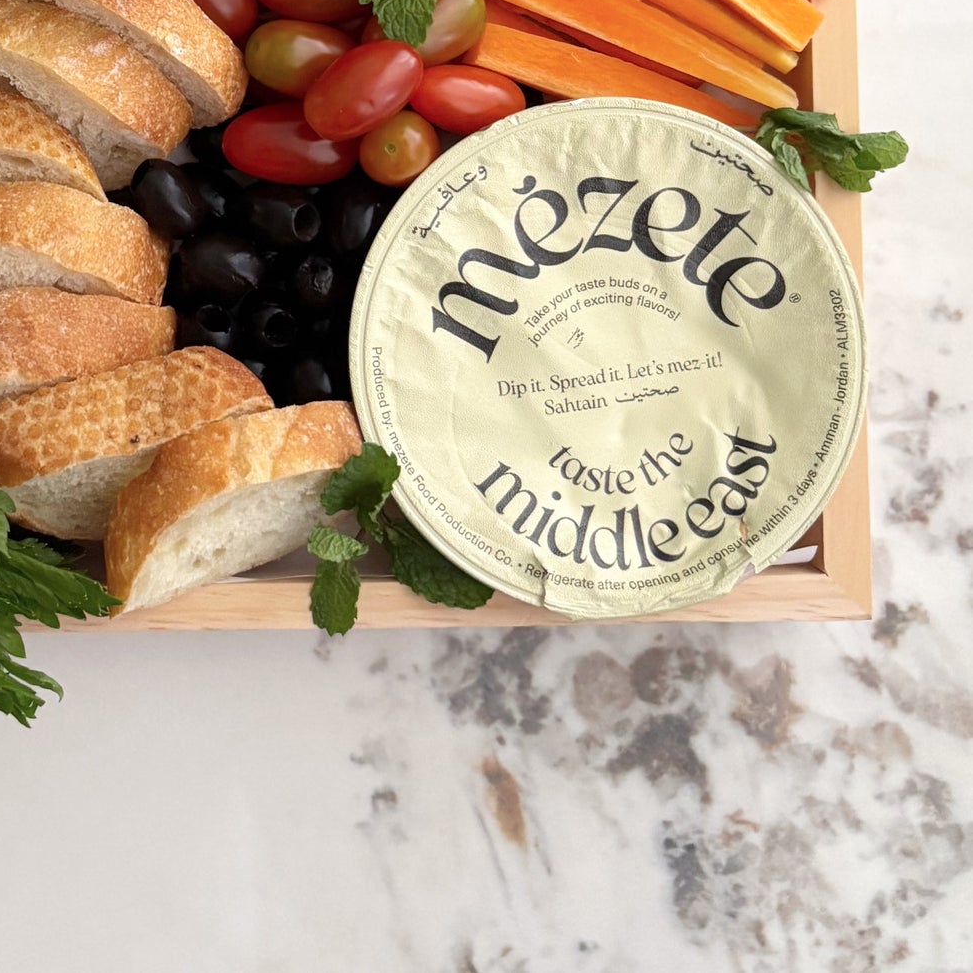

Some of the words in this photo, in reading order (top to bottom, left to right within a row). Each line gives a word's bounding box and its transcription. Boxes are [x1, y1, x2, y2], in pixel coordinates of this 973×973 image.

[690, 139, 773, 196] صحتين
[524, 304, 550, 328] Take
[549, 287, 573, 310] your
[575, 278, 605, 293] taste
[609, 276, 640, 290] buds
[642, 283, 658, 295] on
[659, 291, 668, 300] a
[528, 309, 568, 347] journey
[570, 300, 581, 314] of
[584, 293, 633, 307] exciting
[636, 295, 681, 321] flavors!
[829, 288, 849, 351] ALM3302
[372, 346, 388, 409] Produced
[497, 380, 527, 398] Dip
[531, 378, 545, 393] it.
[550, 370, 605, 393] Spread
[609, 367, 623, 381] it.
[668, 351, 722, 373] mez-it!
[615, 385, 679, 403] صحتين
[833, 362, 849, 404] Jordan
[382, 411, 394, 430] by:
[544, 395, 607, 416] Sahtain
[389, 431, 415, 476] mezete
[815, 414, 841, 462] Amman
[548, 445, 637, 495] taste
[638, 432, 693, 486] the
[796, 470, 817, 497] days
[413, 474, 438, 506] Food
[474, 461, 686, 571] middle
[686, 426, 777, 539] east
[787, 494, 799, 505] 3
[435, 505, 492, 556] Production
[760, 503, 792, 536] within
[494, 549, 513, 567] Co.
[682, 559, 706, 578] and
[597, 580, 625, 591] after
[629, 572, 681, 591] opening
